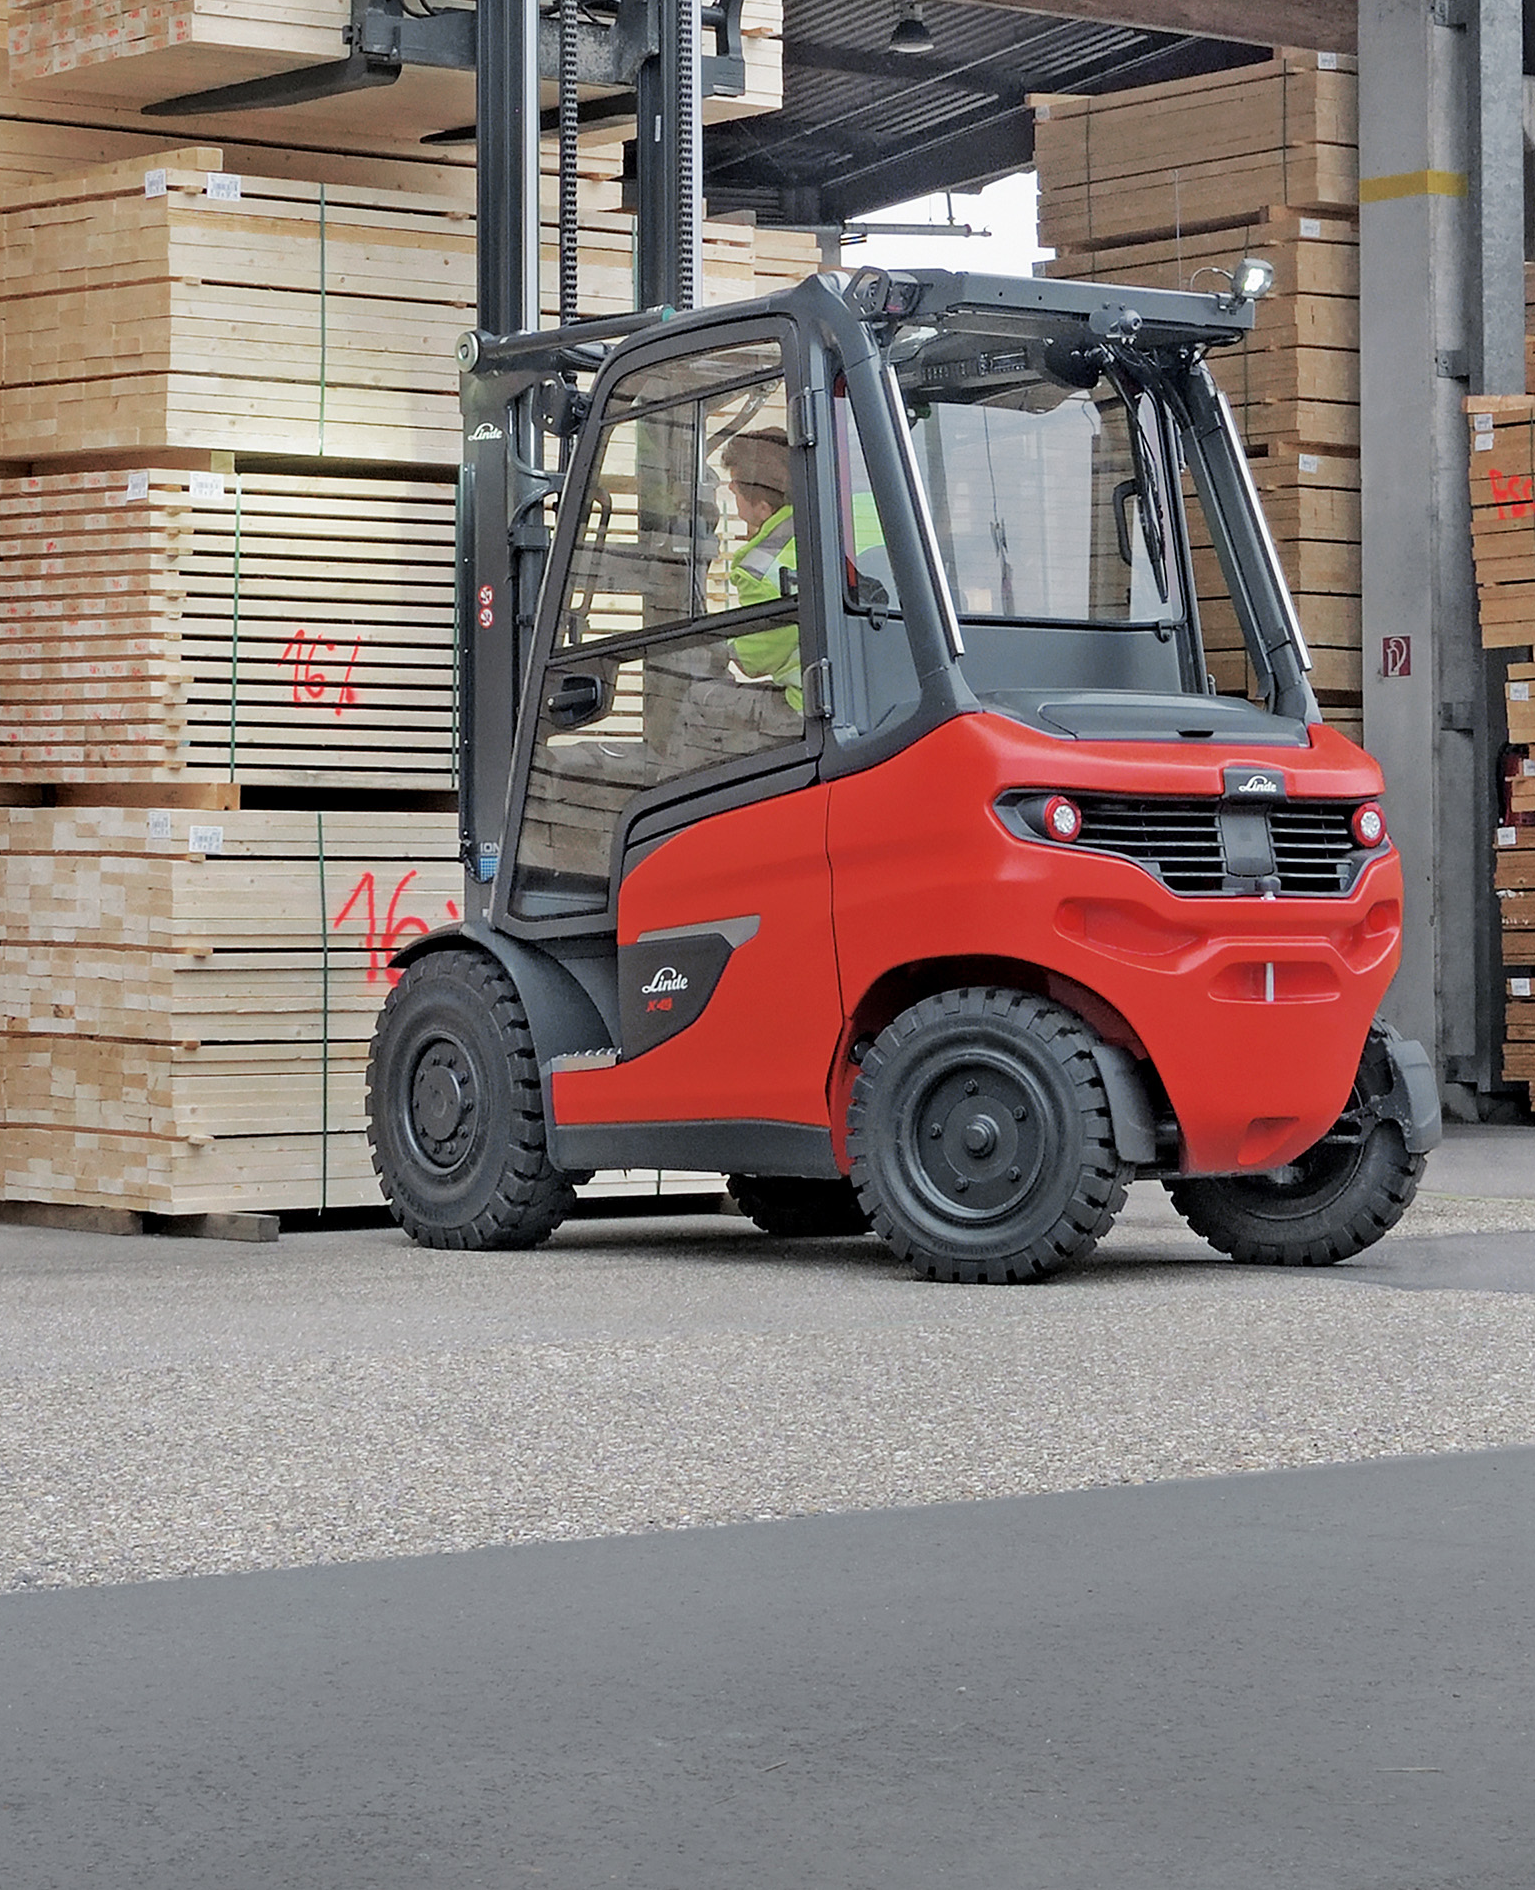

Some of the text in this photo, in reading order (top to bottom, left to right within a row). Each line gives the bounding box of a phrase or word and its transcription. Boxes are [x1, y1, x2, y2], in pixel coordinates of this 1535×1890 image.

[468, 422, 503, 441] Linde
[1238, 775, 1277, 792] Linde
[642, 967, 688, 993] Linde
